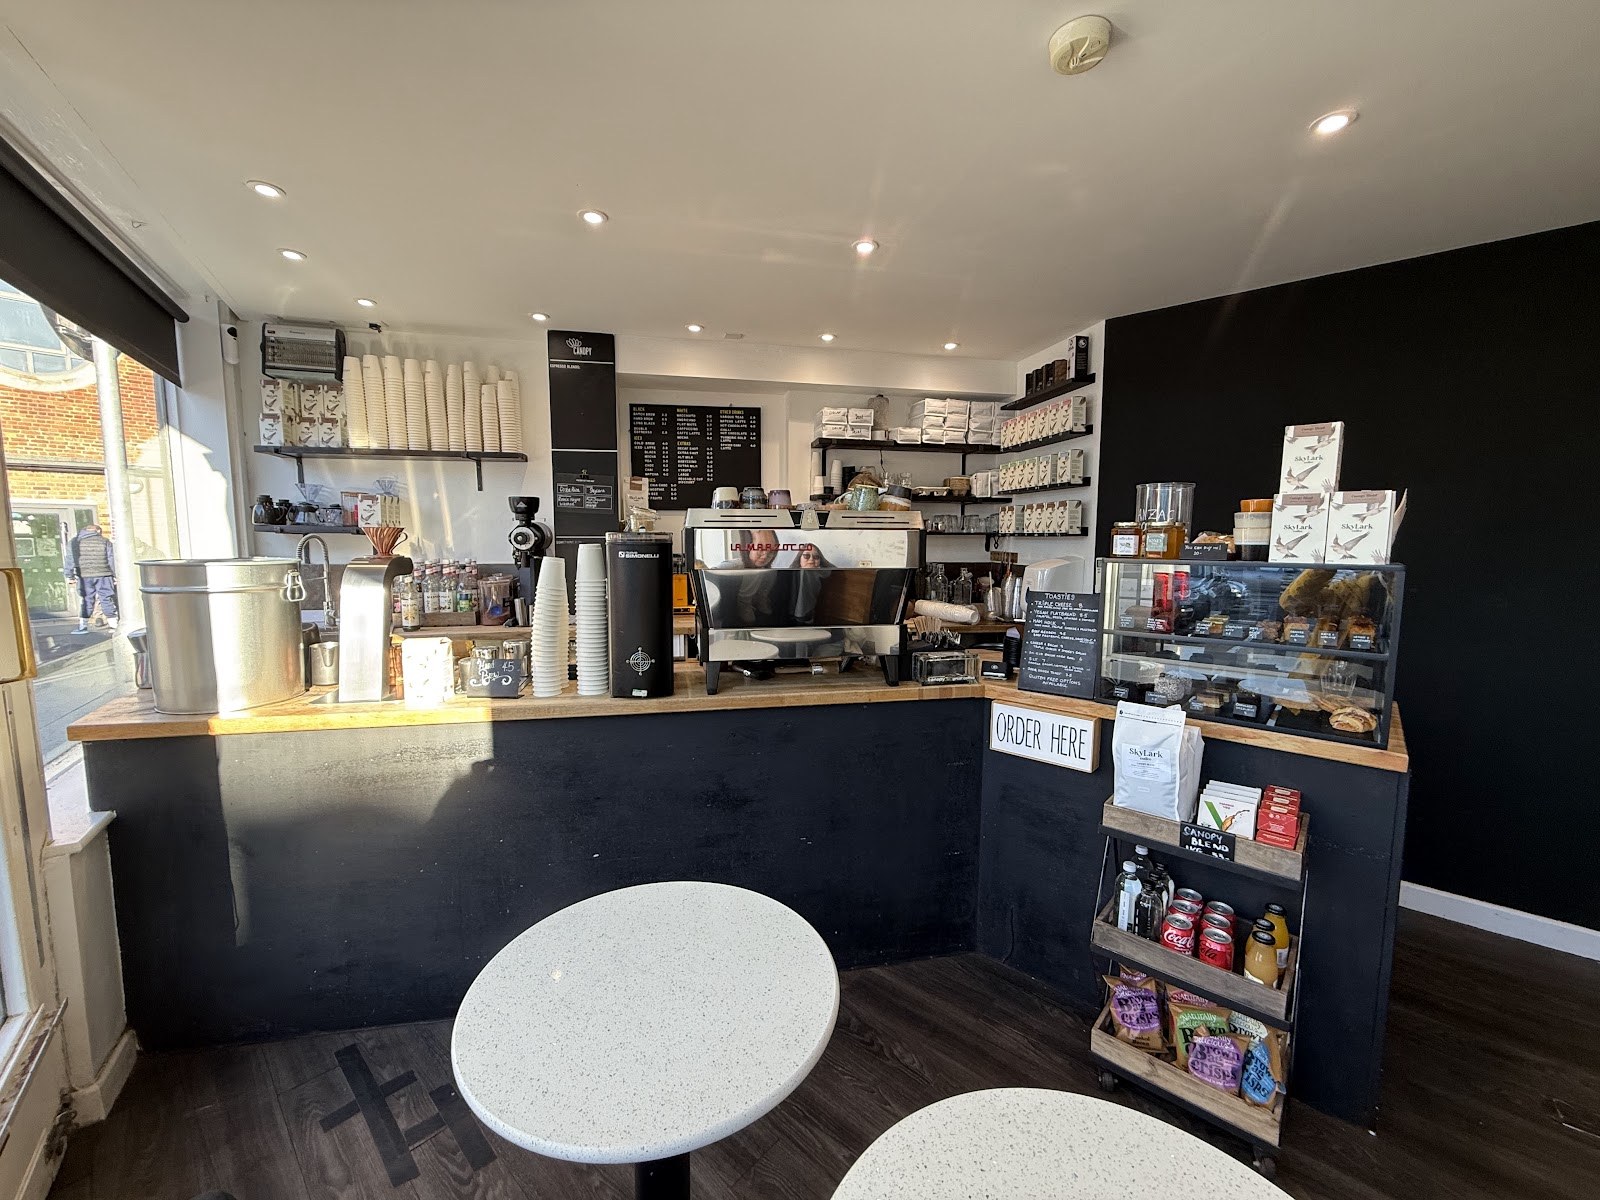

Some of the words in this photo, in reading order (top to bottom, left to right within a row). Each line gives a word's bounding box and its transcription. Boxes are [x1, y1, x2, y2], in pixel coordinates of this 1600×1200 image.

[573, 347, 592, 356] CANOPY
[996, 713, 1041, 750] ORDER
[1051, 723, 1087, 760] HERE
[1129, 748, 1163, 758] SkyLark
[1184, 826, 1223, 844] CANOPY
[1191, 837, 1229, 852] BLEND
[1195, 1044, 1241, 1062] Brown
